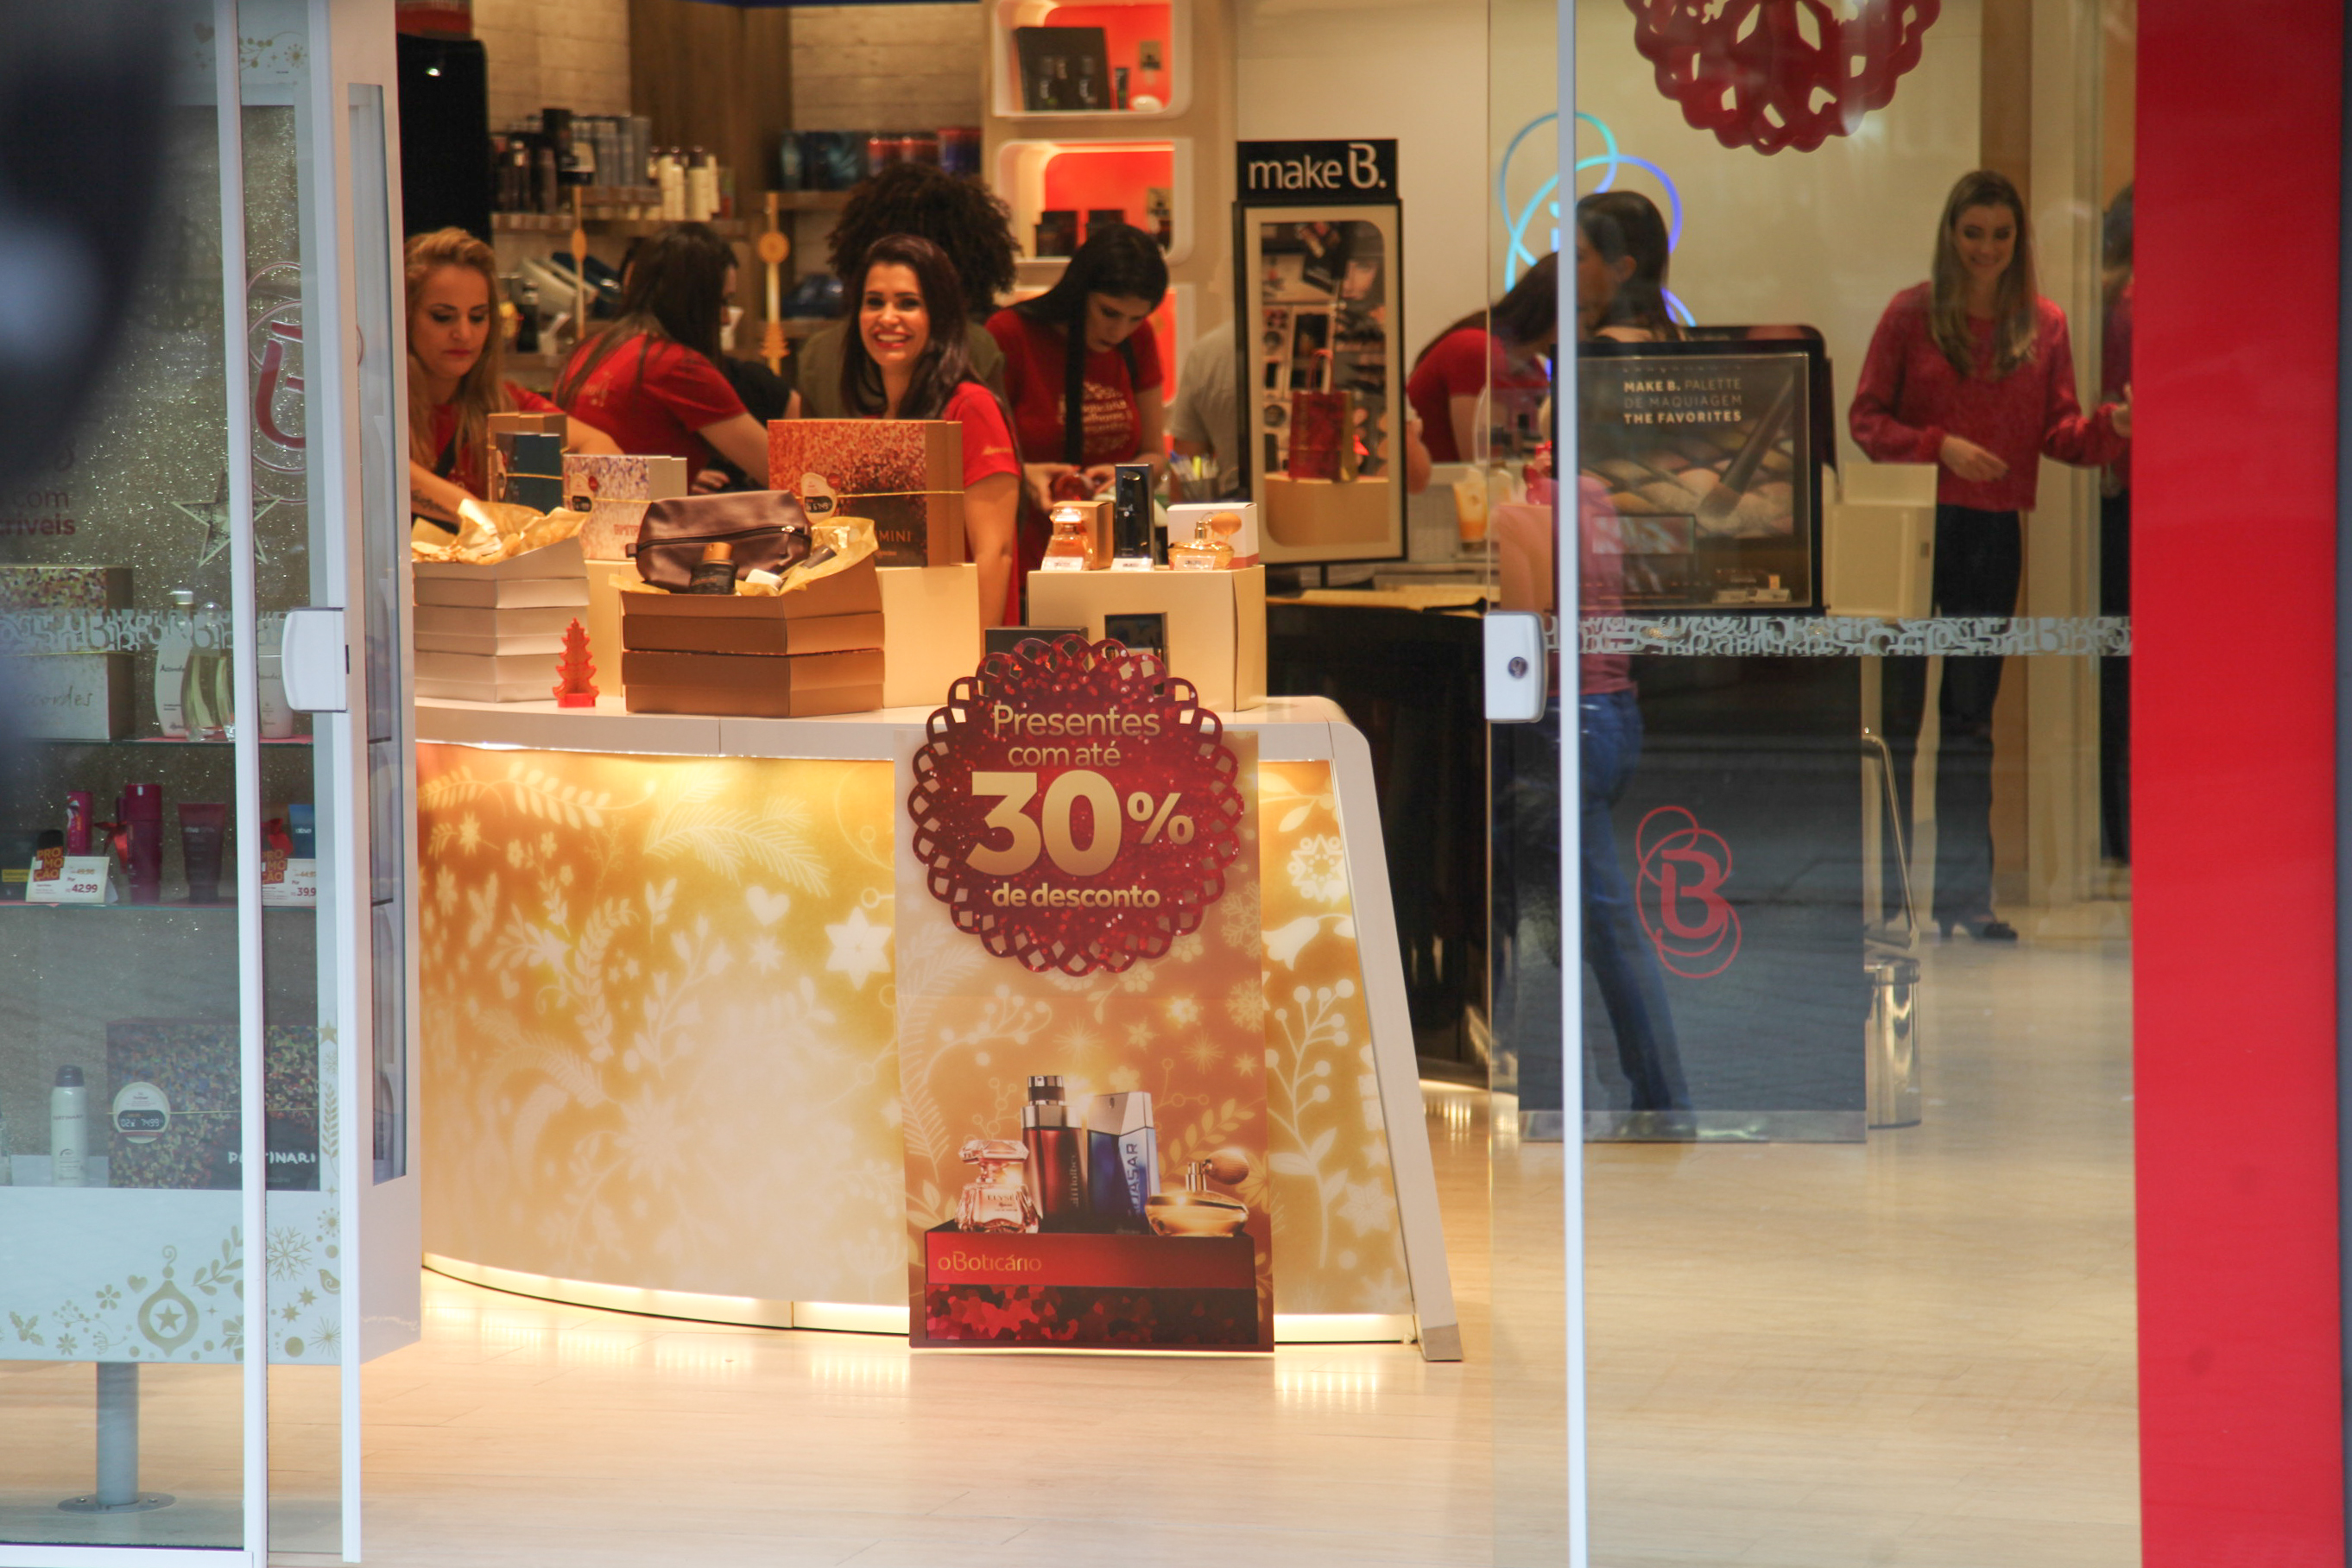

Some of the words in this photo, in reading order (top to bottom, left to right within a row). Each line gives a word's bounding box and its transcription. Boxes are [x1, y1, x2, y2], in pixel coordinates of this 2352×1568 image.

[1249, 155, 1343, 189] make
[1348, 142, 1387, 189] B.
[1623, 381, 1664, 392] MAKE
[1666, 380, 1680, 391] B.
[1685, 377, 1742, 391] PALETTE
[1623, 397, 1643, 409] DE
[1649, 395, 1742, 408] MAQUIAGEM
[1623, 413, 1653, 424] THE
[1657, 410, 1742, 424] FAVORITES
[875, 530, 911, 543] MINI
[994, 705, 1160, 736] Presentes
[1008, 746, 1070, 767] com
[1074, 741, 1121, 767] até
[965, 769, 1195, 876] 30%
[992, 882, 1027, 907] de
[1031, 882, 1160, 907] desconto
